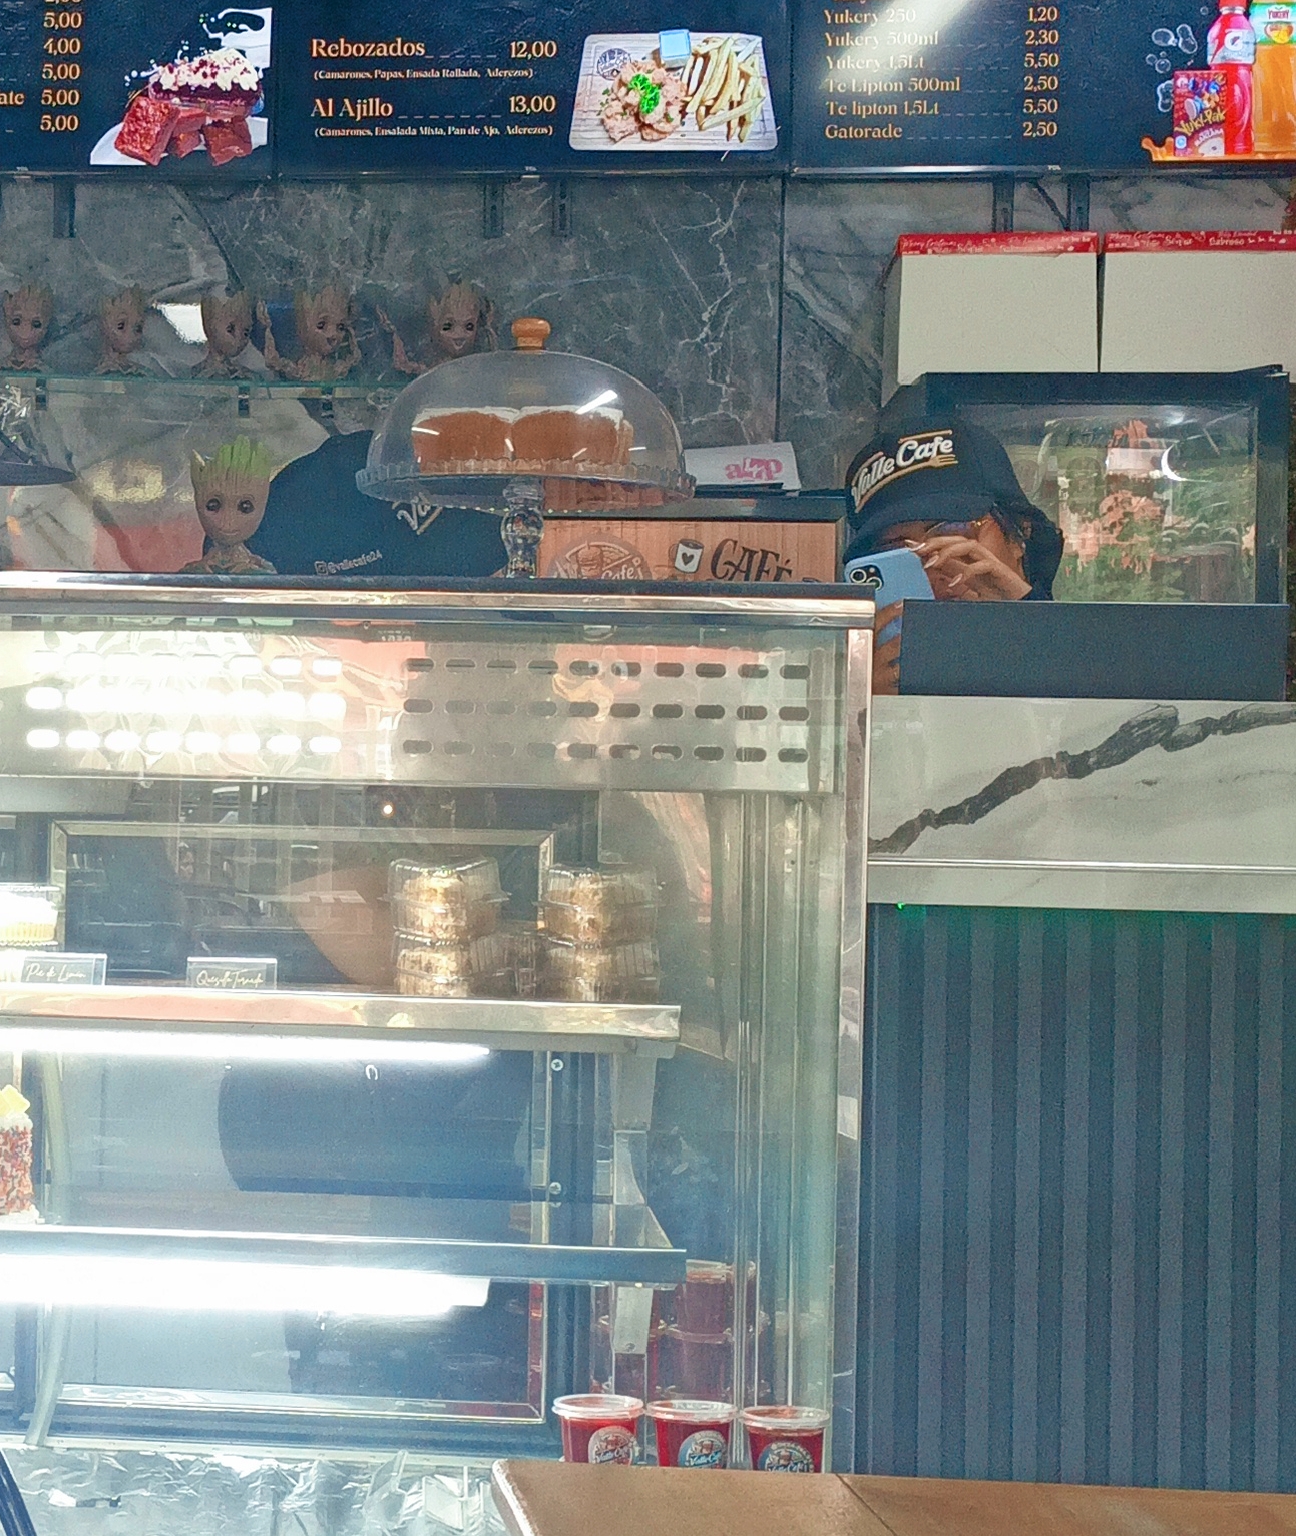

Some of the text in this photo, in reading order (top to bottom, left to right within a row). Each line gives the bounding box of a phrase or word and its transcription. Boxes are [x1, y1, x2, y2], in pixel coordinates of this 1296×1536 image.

[43, 12, 82, 30] 5,00
[824, 7, 1059, 27] Yukery 250 1,20
[43, 38, 81, 56] 4,00
[311, 38, 557, 59] Rebozados 12,00
[825, 30, 1059, 50] Yukery 500ml 2,30
[1024, 53, 1060, 70] 5,50
[42, 64, 81, 81] 5,00
[851, 78, 903, 96] Lipton
[908, 76, 961, 92] 500ml
[1024, 76, 1059, 93] 2,50
[41, 89, 80, 107] 5,00
[310, 95, 556, 122] Al Ajillo 13,00
[1023, 99, 1059, 116] 5,50
[40, 115, 79, 133] 5,00
[825, 122, 1058, 140] Gatorade 2,50
[851, 456, 895, 506] Valle
